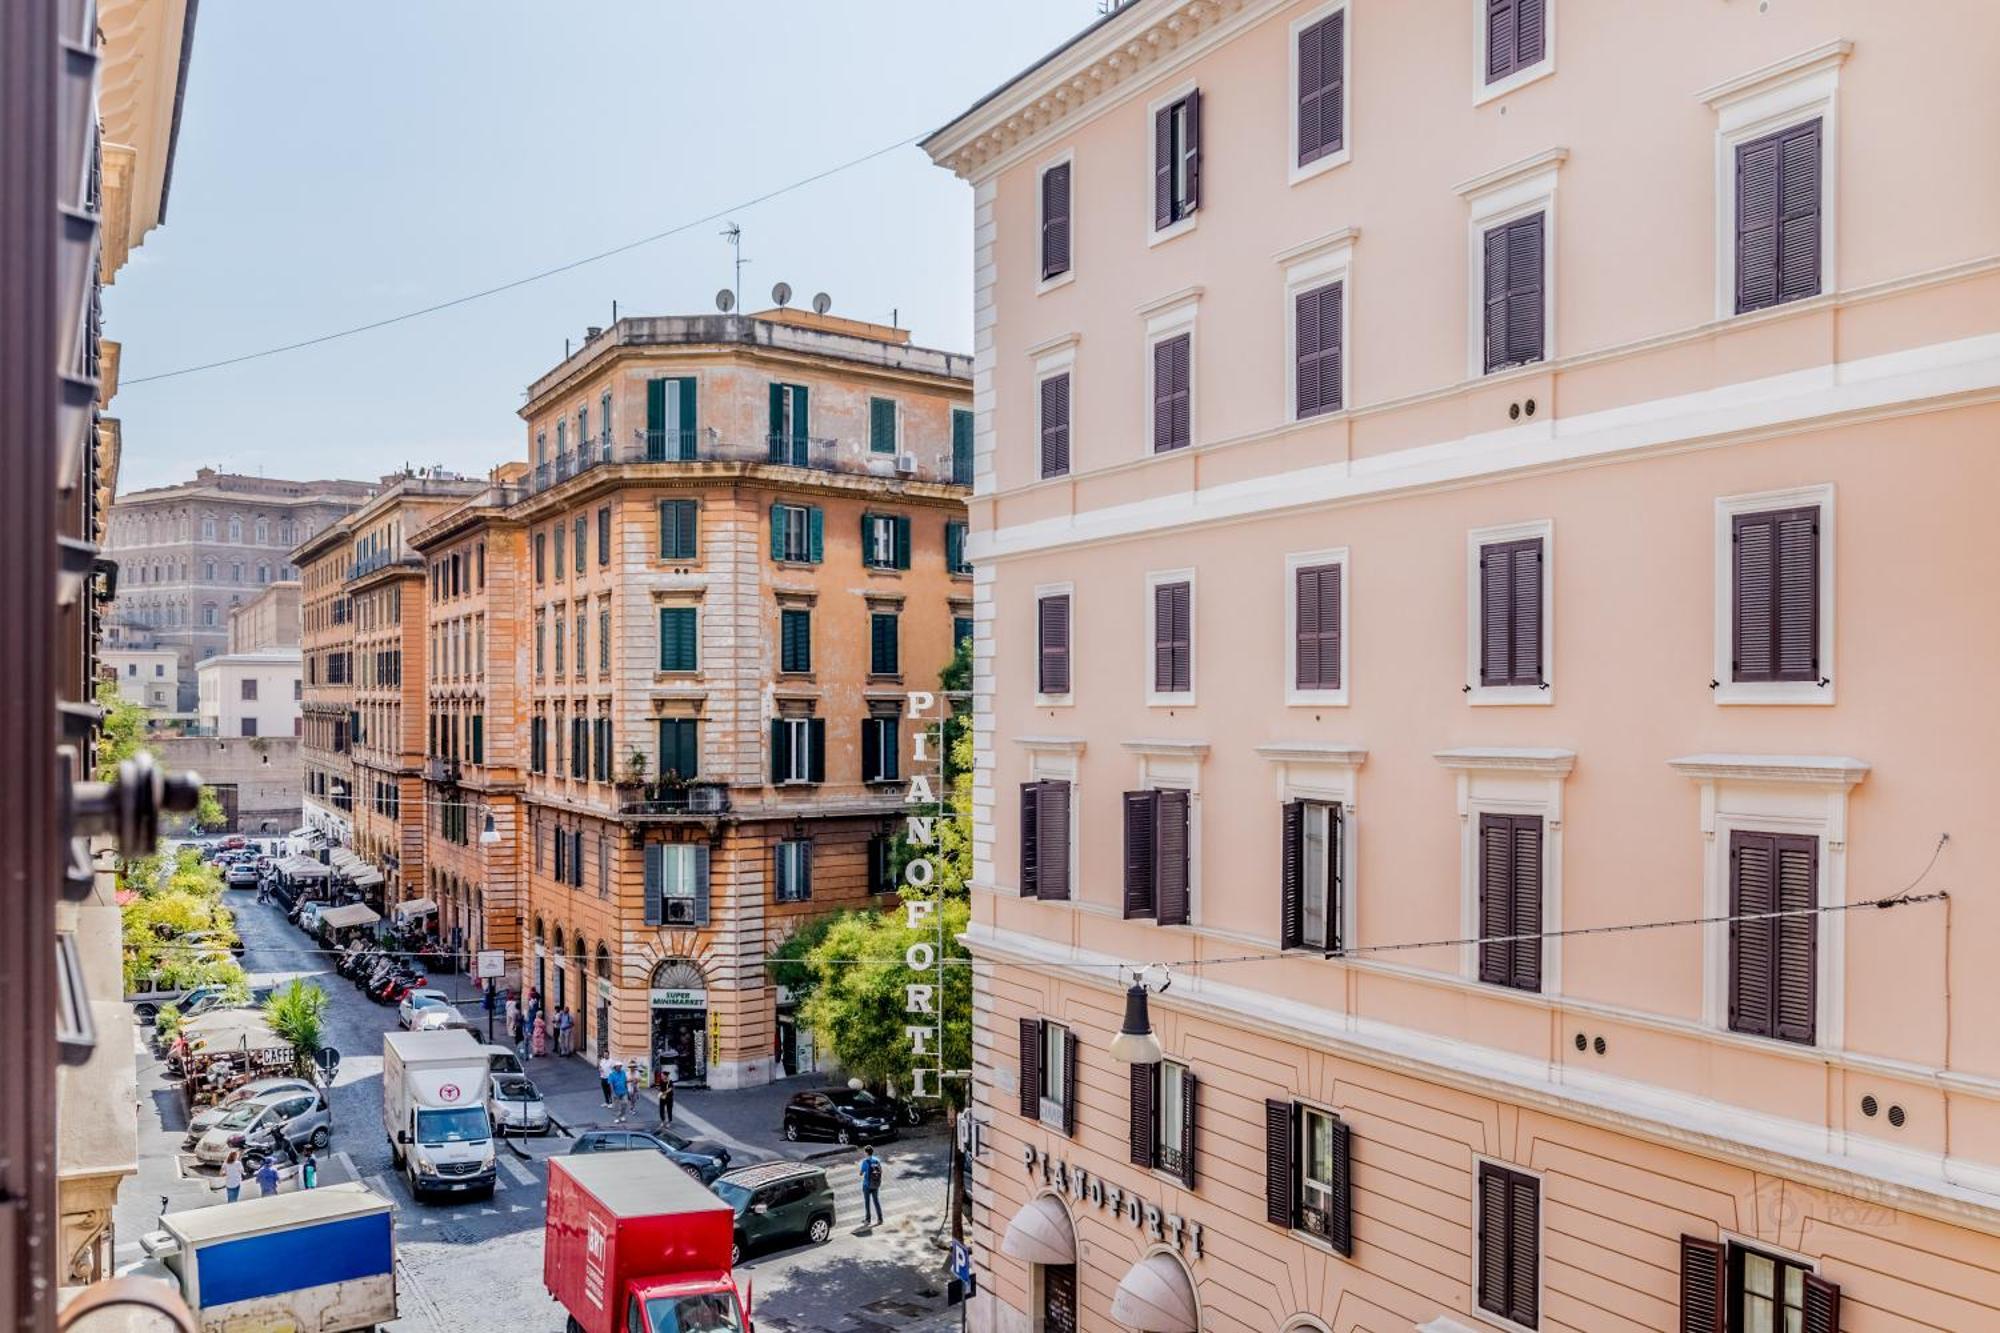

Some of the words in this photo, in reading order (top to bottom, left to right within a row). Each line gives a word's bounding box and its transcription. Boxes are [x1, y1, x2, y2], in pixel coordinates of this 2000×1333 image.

[904, 691, 936, 1098] PIANOFORTI
[956, 1245, 965, 1273] P
[1023, 1143, 1204, 1259] PIANOFORTI
